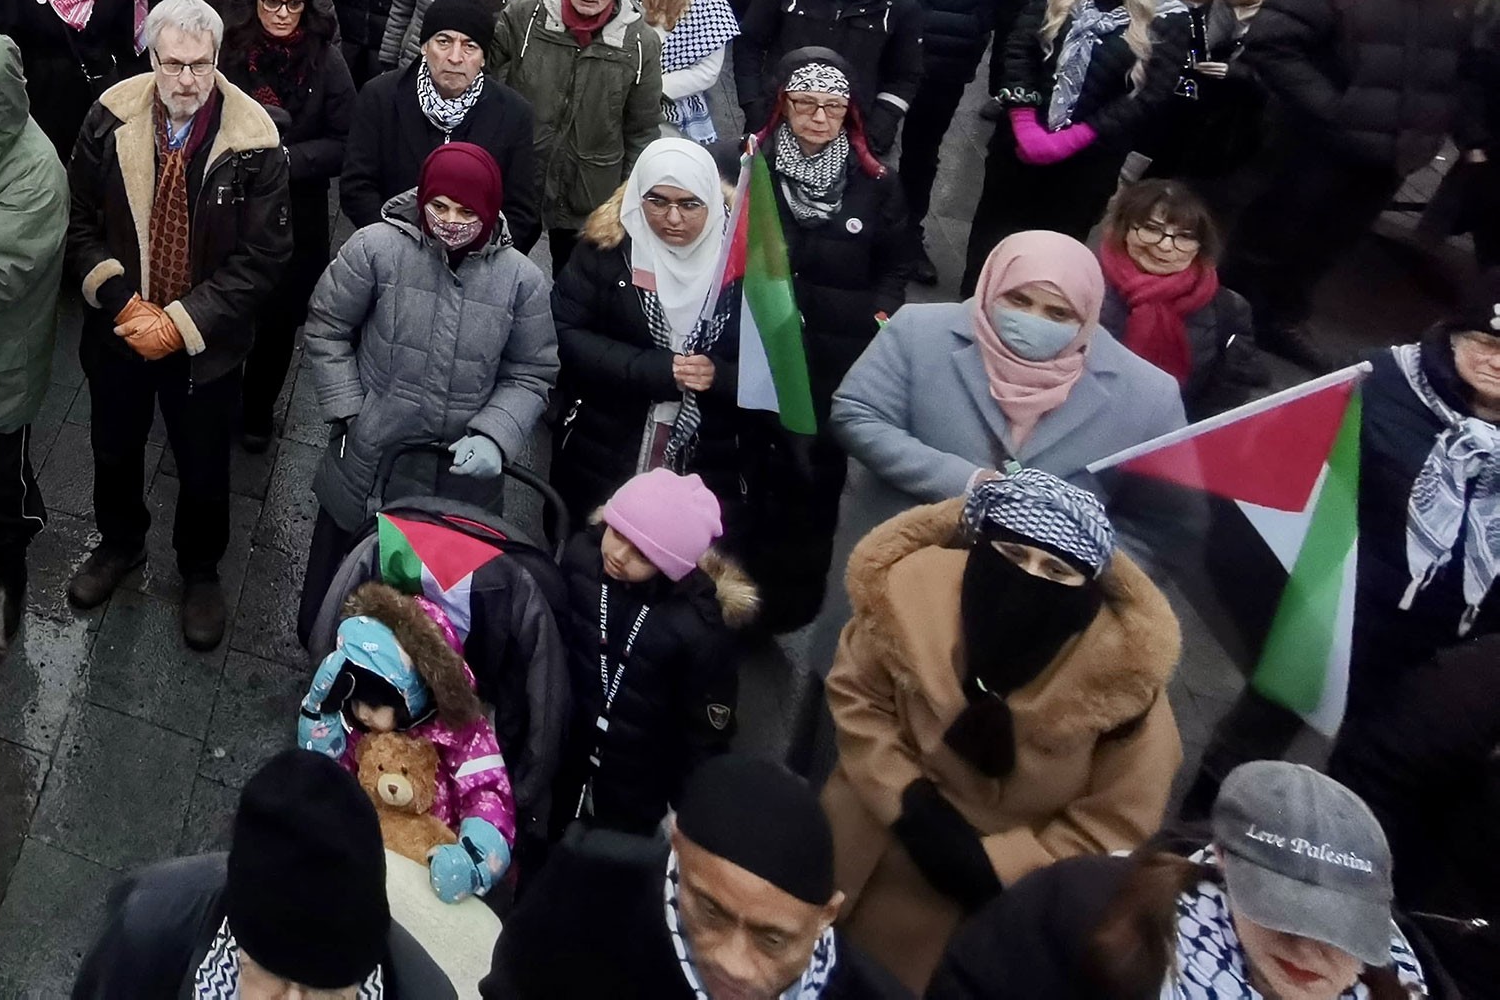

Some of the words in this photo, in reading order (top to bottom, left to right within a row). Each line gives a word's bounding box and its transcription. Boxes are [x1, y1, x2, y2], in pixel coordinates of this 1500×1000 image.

[600, 583, 609, 630] PALESTINE
[627, 603, 650, 645] PALESTINE
[607, 662, 626, 703] PALESTINE
[1245, 823, 1287, 849] Love
